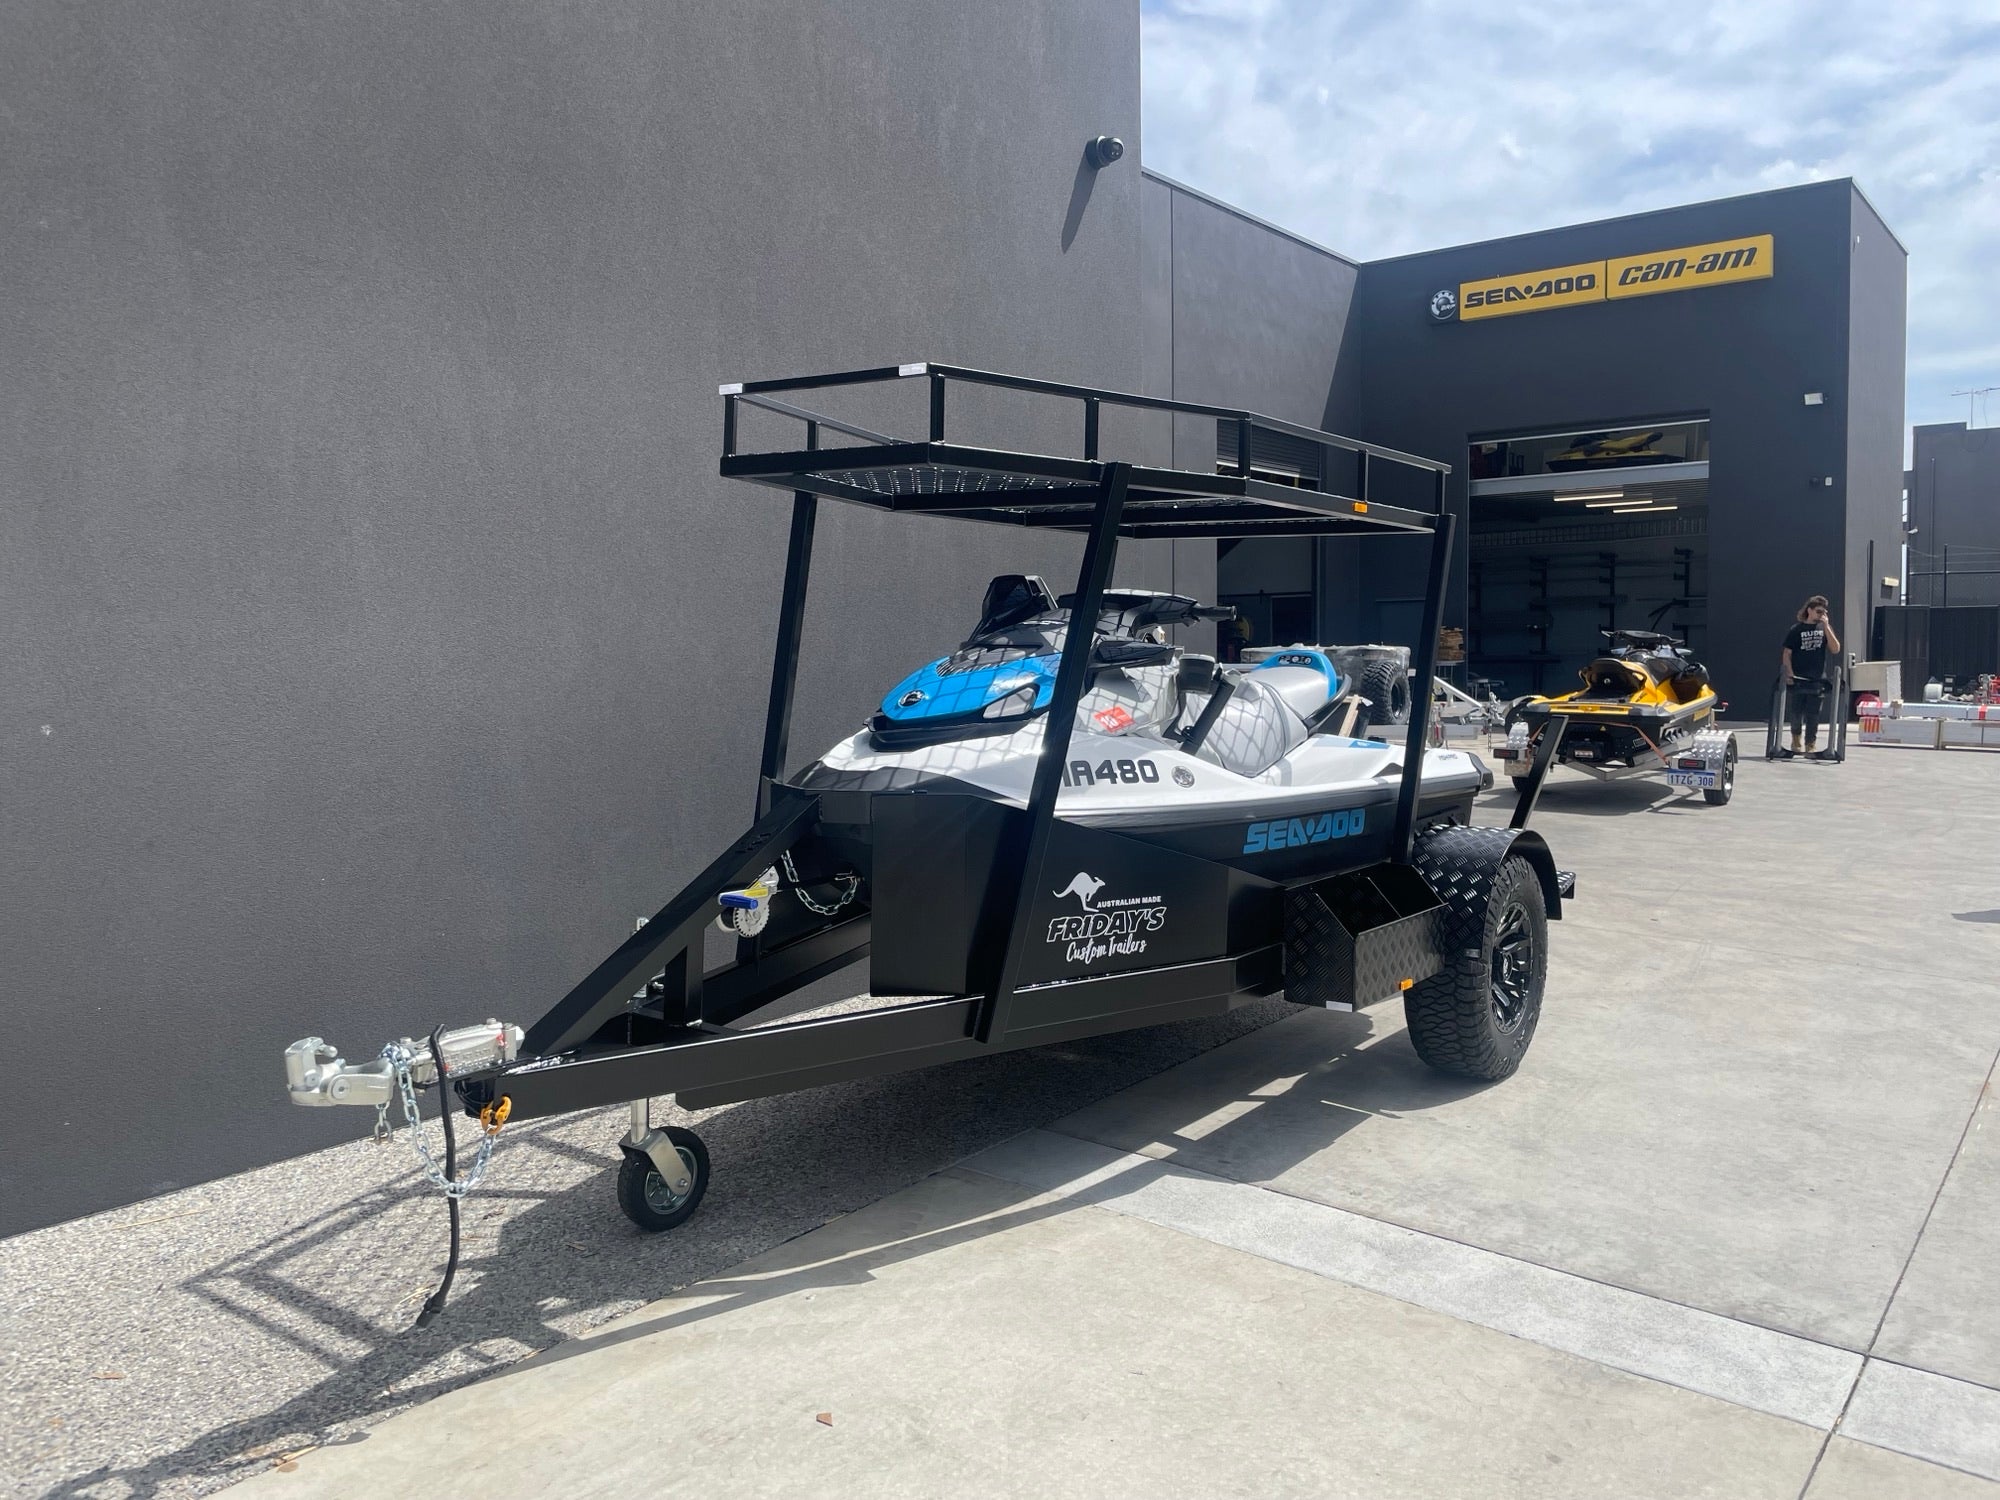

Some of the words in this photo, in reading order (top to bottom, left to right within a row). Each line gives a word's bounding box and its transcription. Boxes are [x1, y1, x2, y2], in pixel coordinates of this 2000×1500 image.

[1096, 897, 1141, 909] AUSTRALIAN
[1141, 895, 1162, 904] MADE
[1046, 906, 1167, 943] FRIDAY'S
[1066, 937, 1107, 965] Custom
[1107, 932, 1147, 957] Trailers
